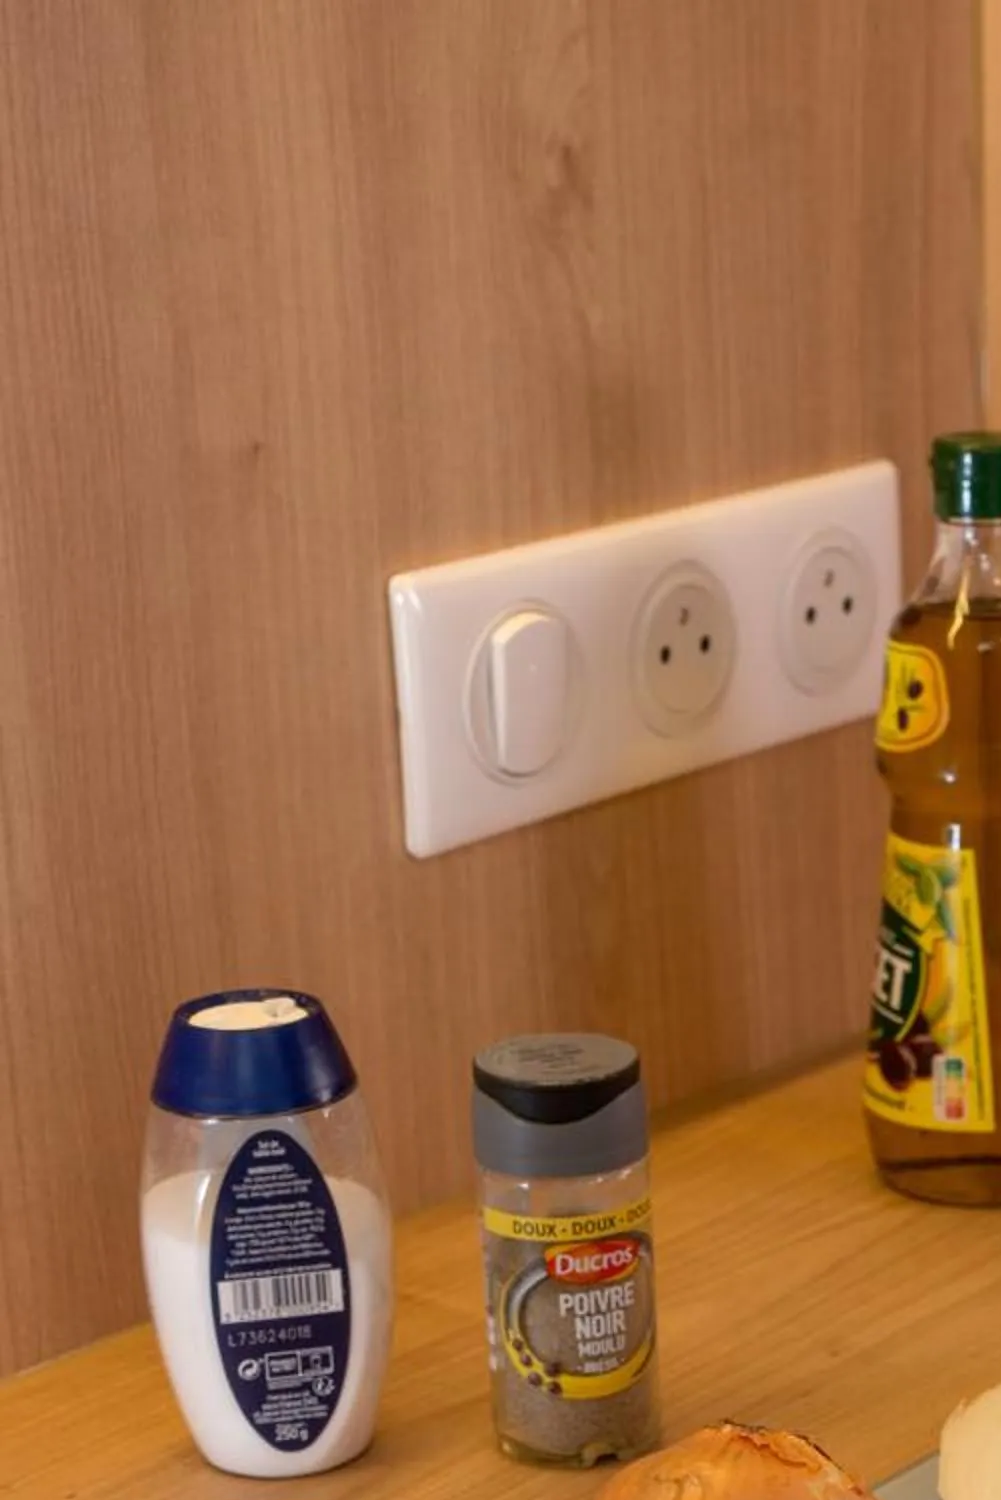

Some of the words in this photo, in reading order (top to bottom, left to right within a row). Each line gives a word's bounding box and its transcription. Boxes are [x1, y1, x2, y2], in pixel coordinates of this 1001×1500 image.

[512, 1219, 558, 1237] DOUX
[571, 1215, 617, 1235] DOUX
[555, 1246, 634, 1276] Ducros
[559, 1281, 636, 1317] POIVRE
[574, 1309, 627, 1340] NOIR
[577, 1334, 626, 1358] MOULU
